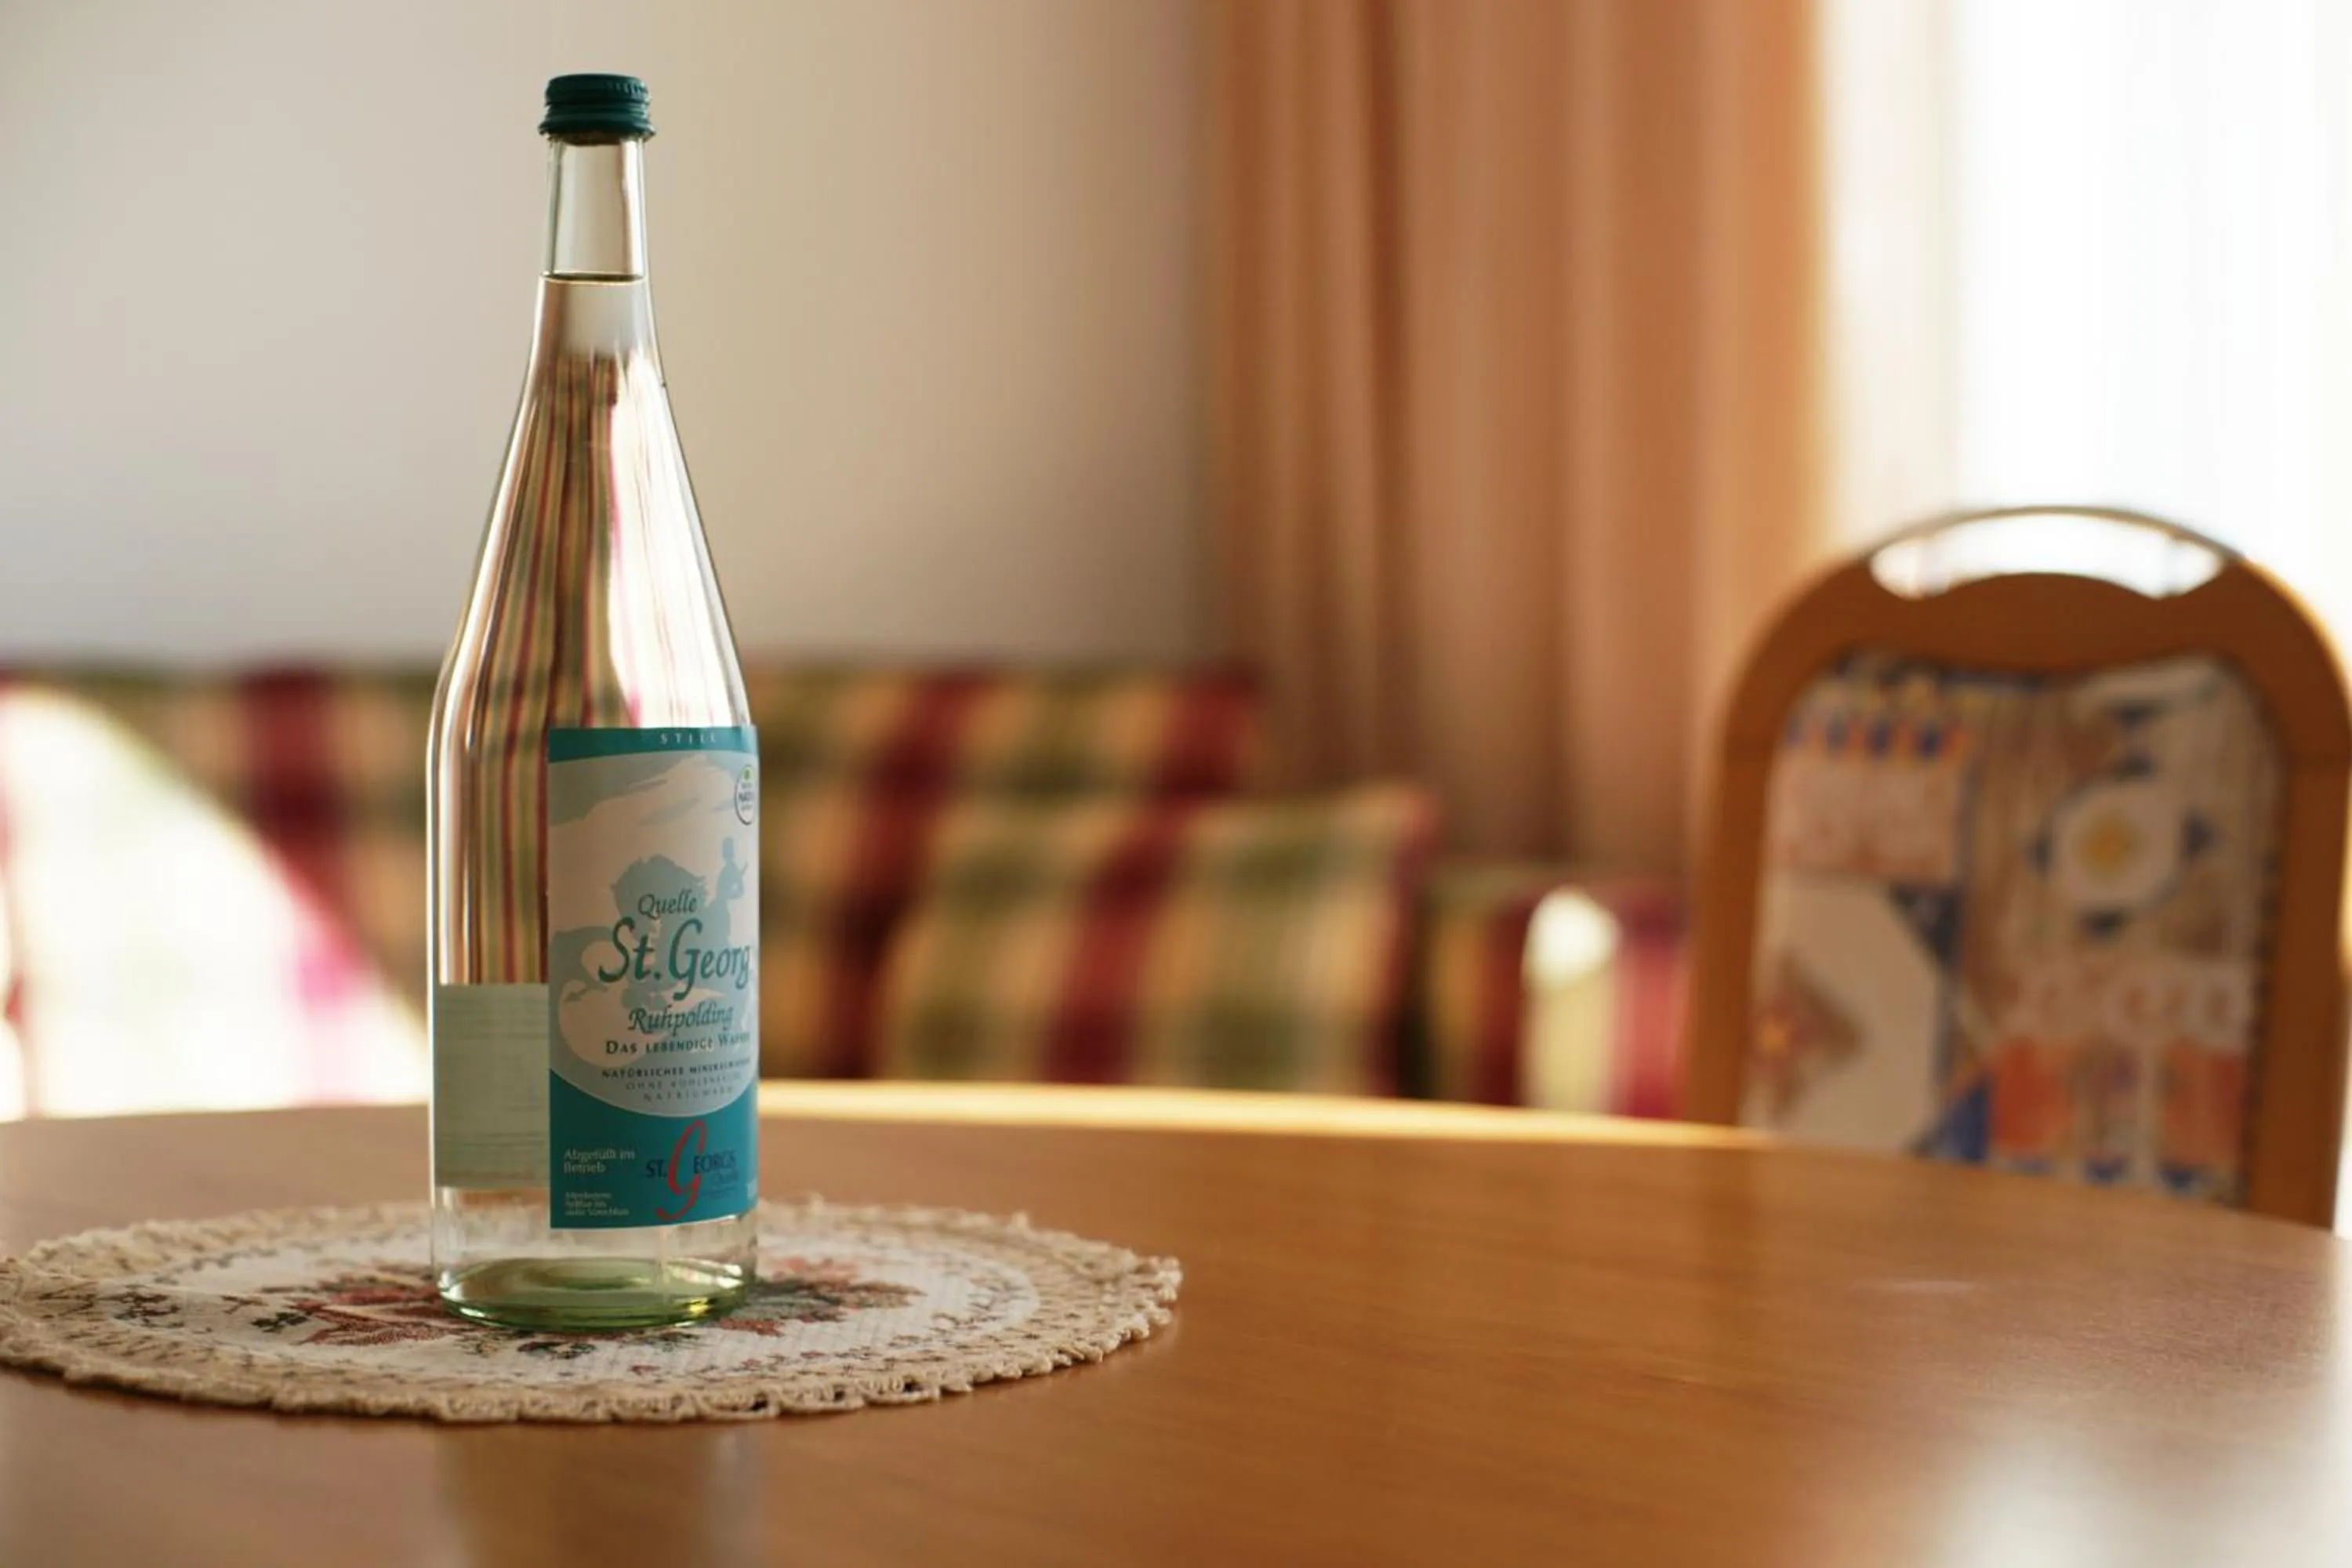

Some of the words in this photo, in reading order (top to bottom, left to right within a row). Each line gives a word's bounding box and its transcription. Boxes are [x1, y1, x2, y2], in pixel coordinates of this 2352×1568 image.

[659, 731, 716, 744] STILL
[638, 888, 697, 920] Quelle
[627, 1000, 734, 1037] Ruhpolding
